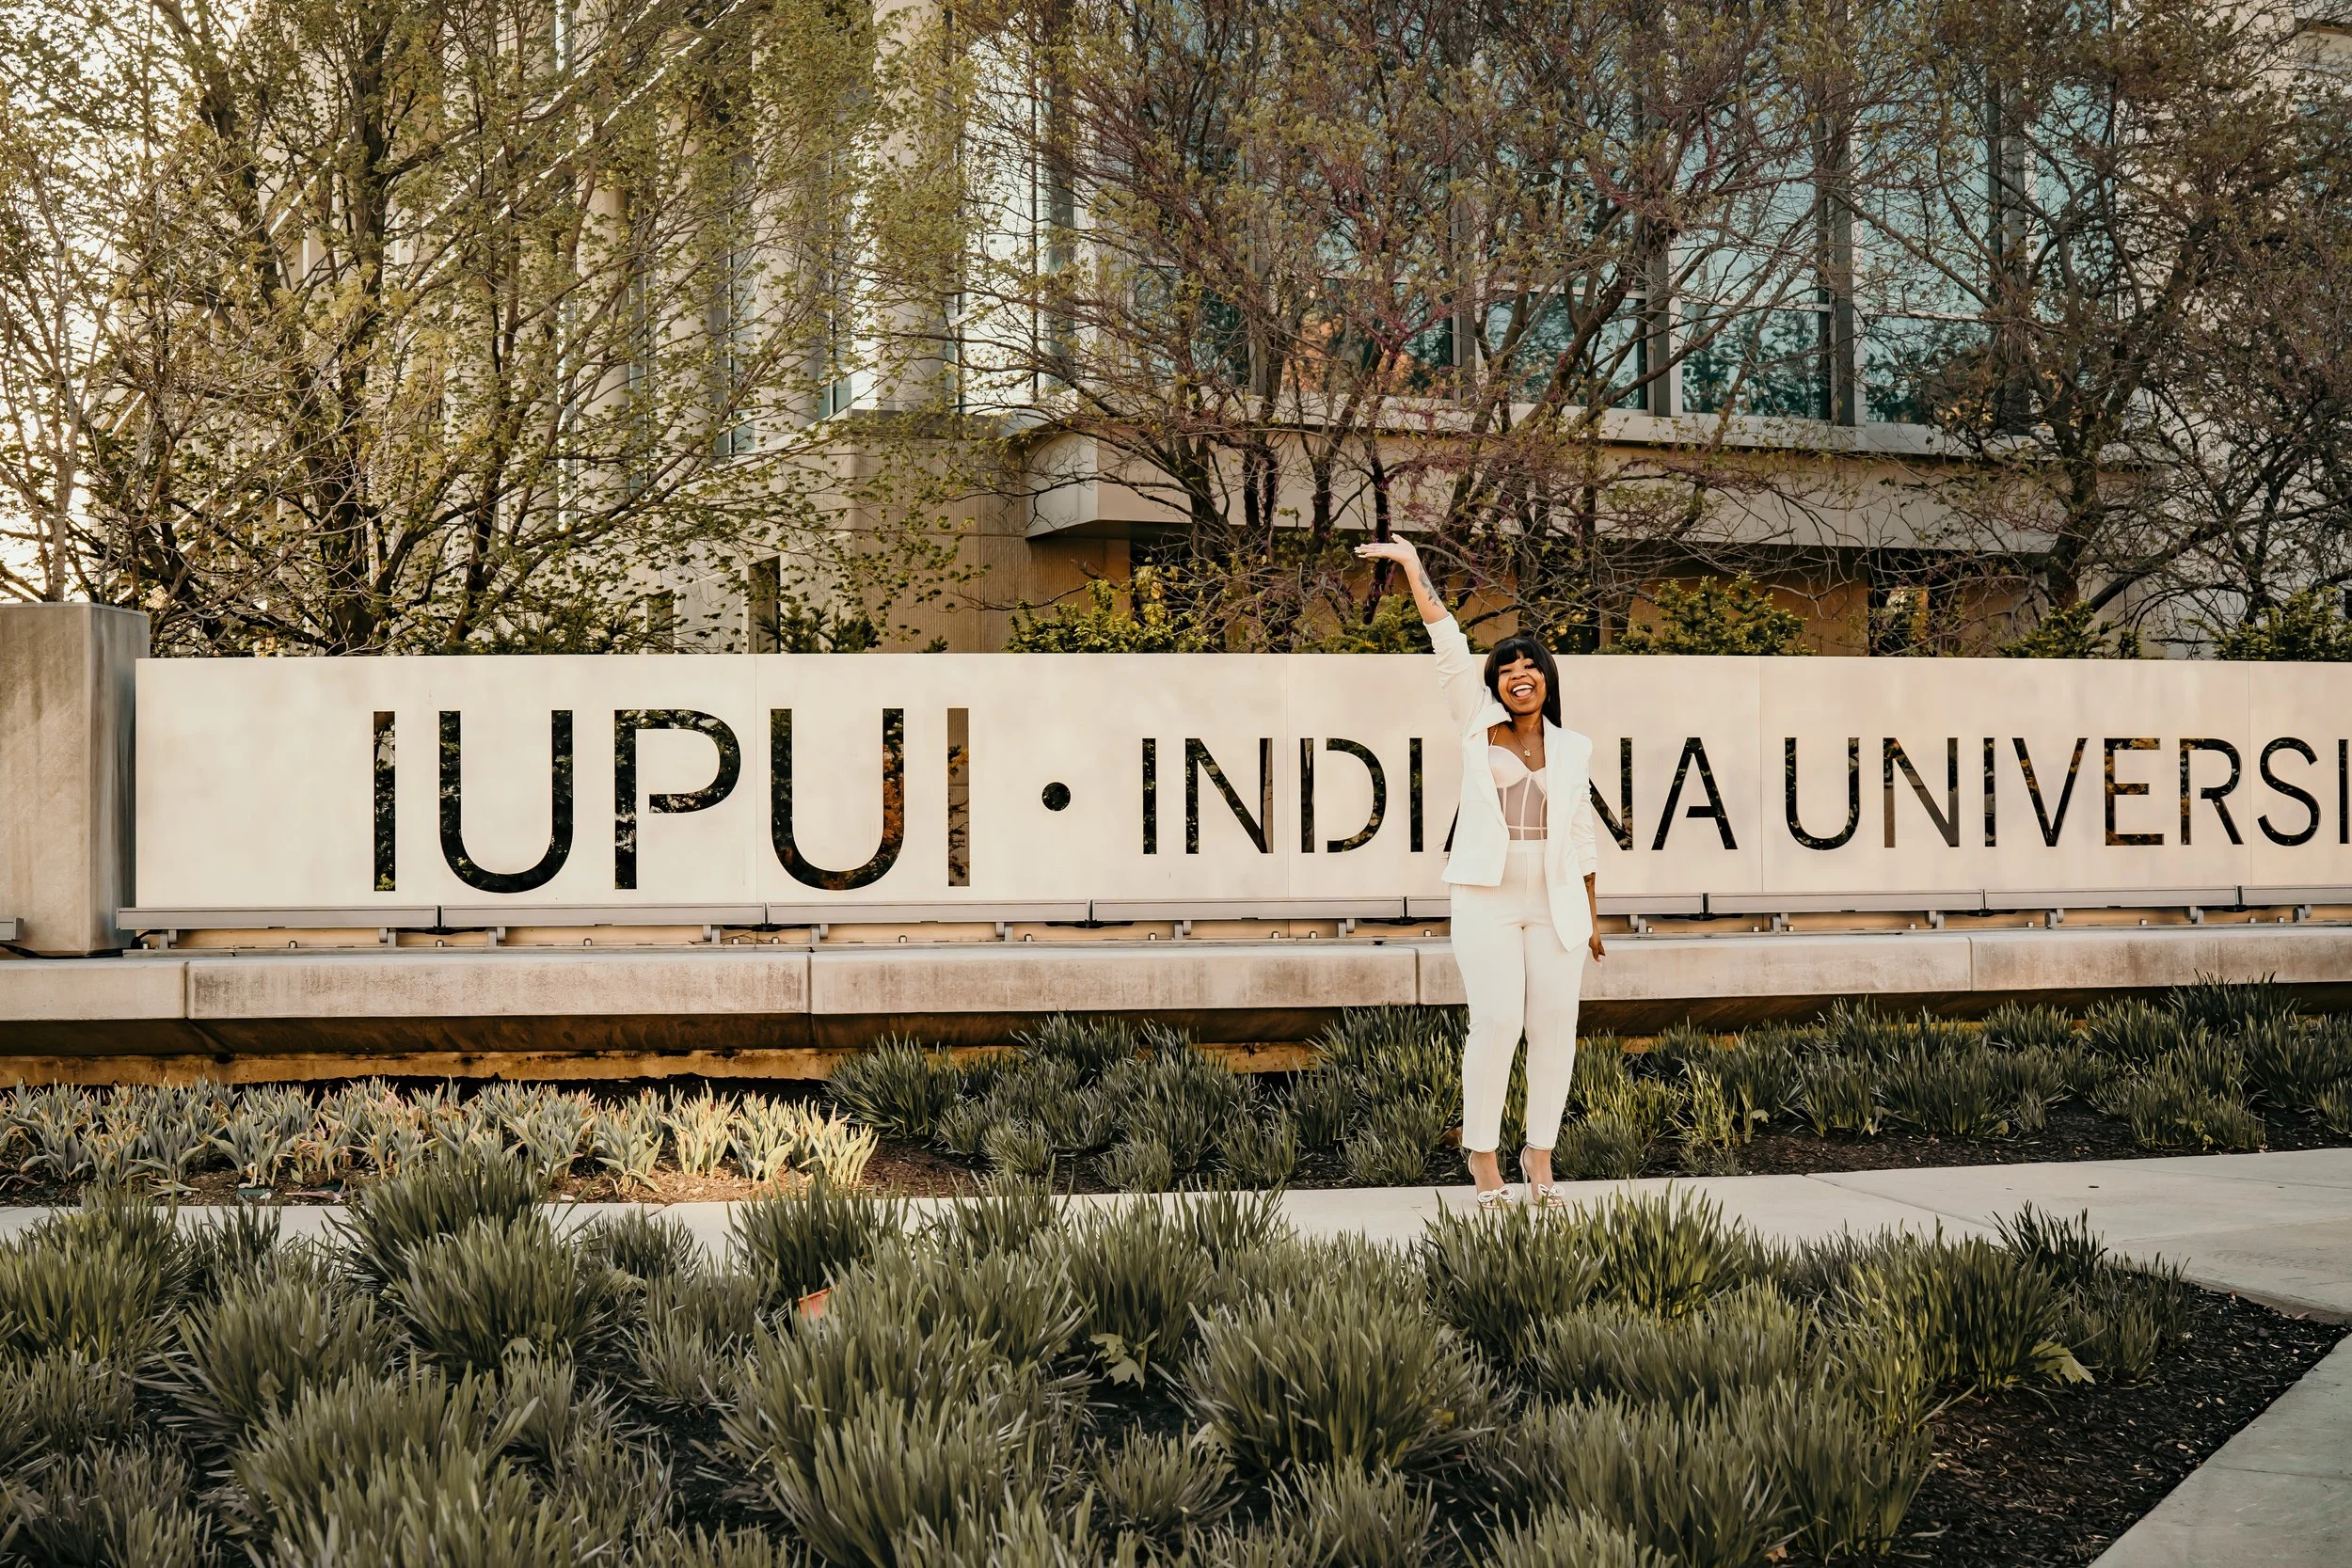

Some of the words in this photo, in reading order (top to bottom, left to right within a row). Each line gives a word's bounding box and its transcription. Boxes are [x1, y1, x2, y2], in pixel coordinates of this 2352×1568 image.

[373, 708, 970, 893] IUPUI
[1142, 736, 1739, 854] INDINA
[1784, 736, 2350, 850] UNIVERSI
